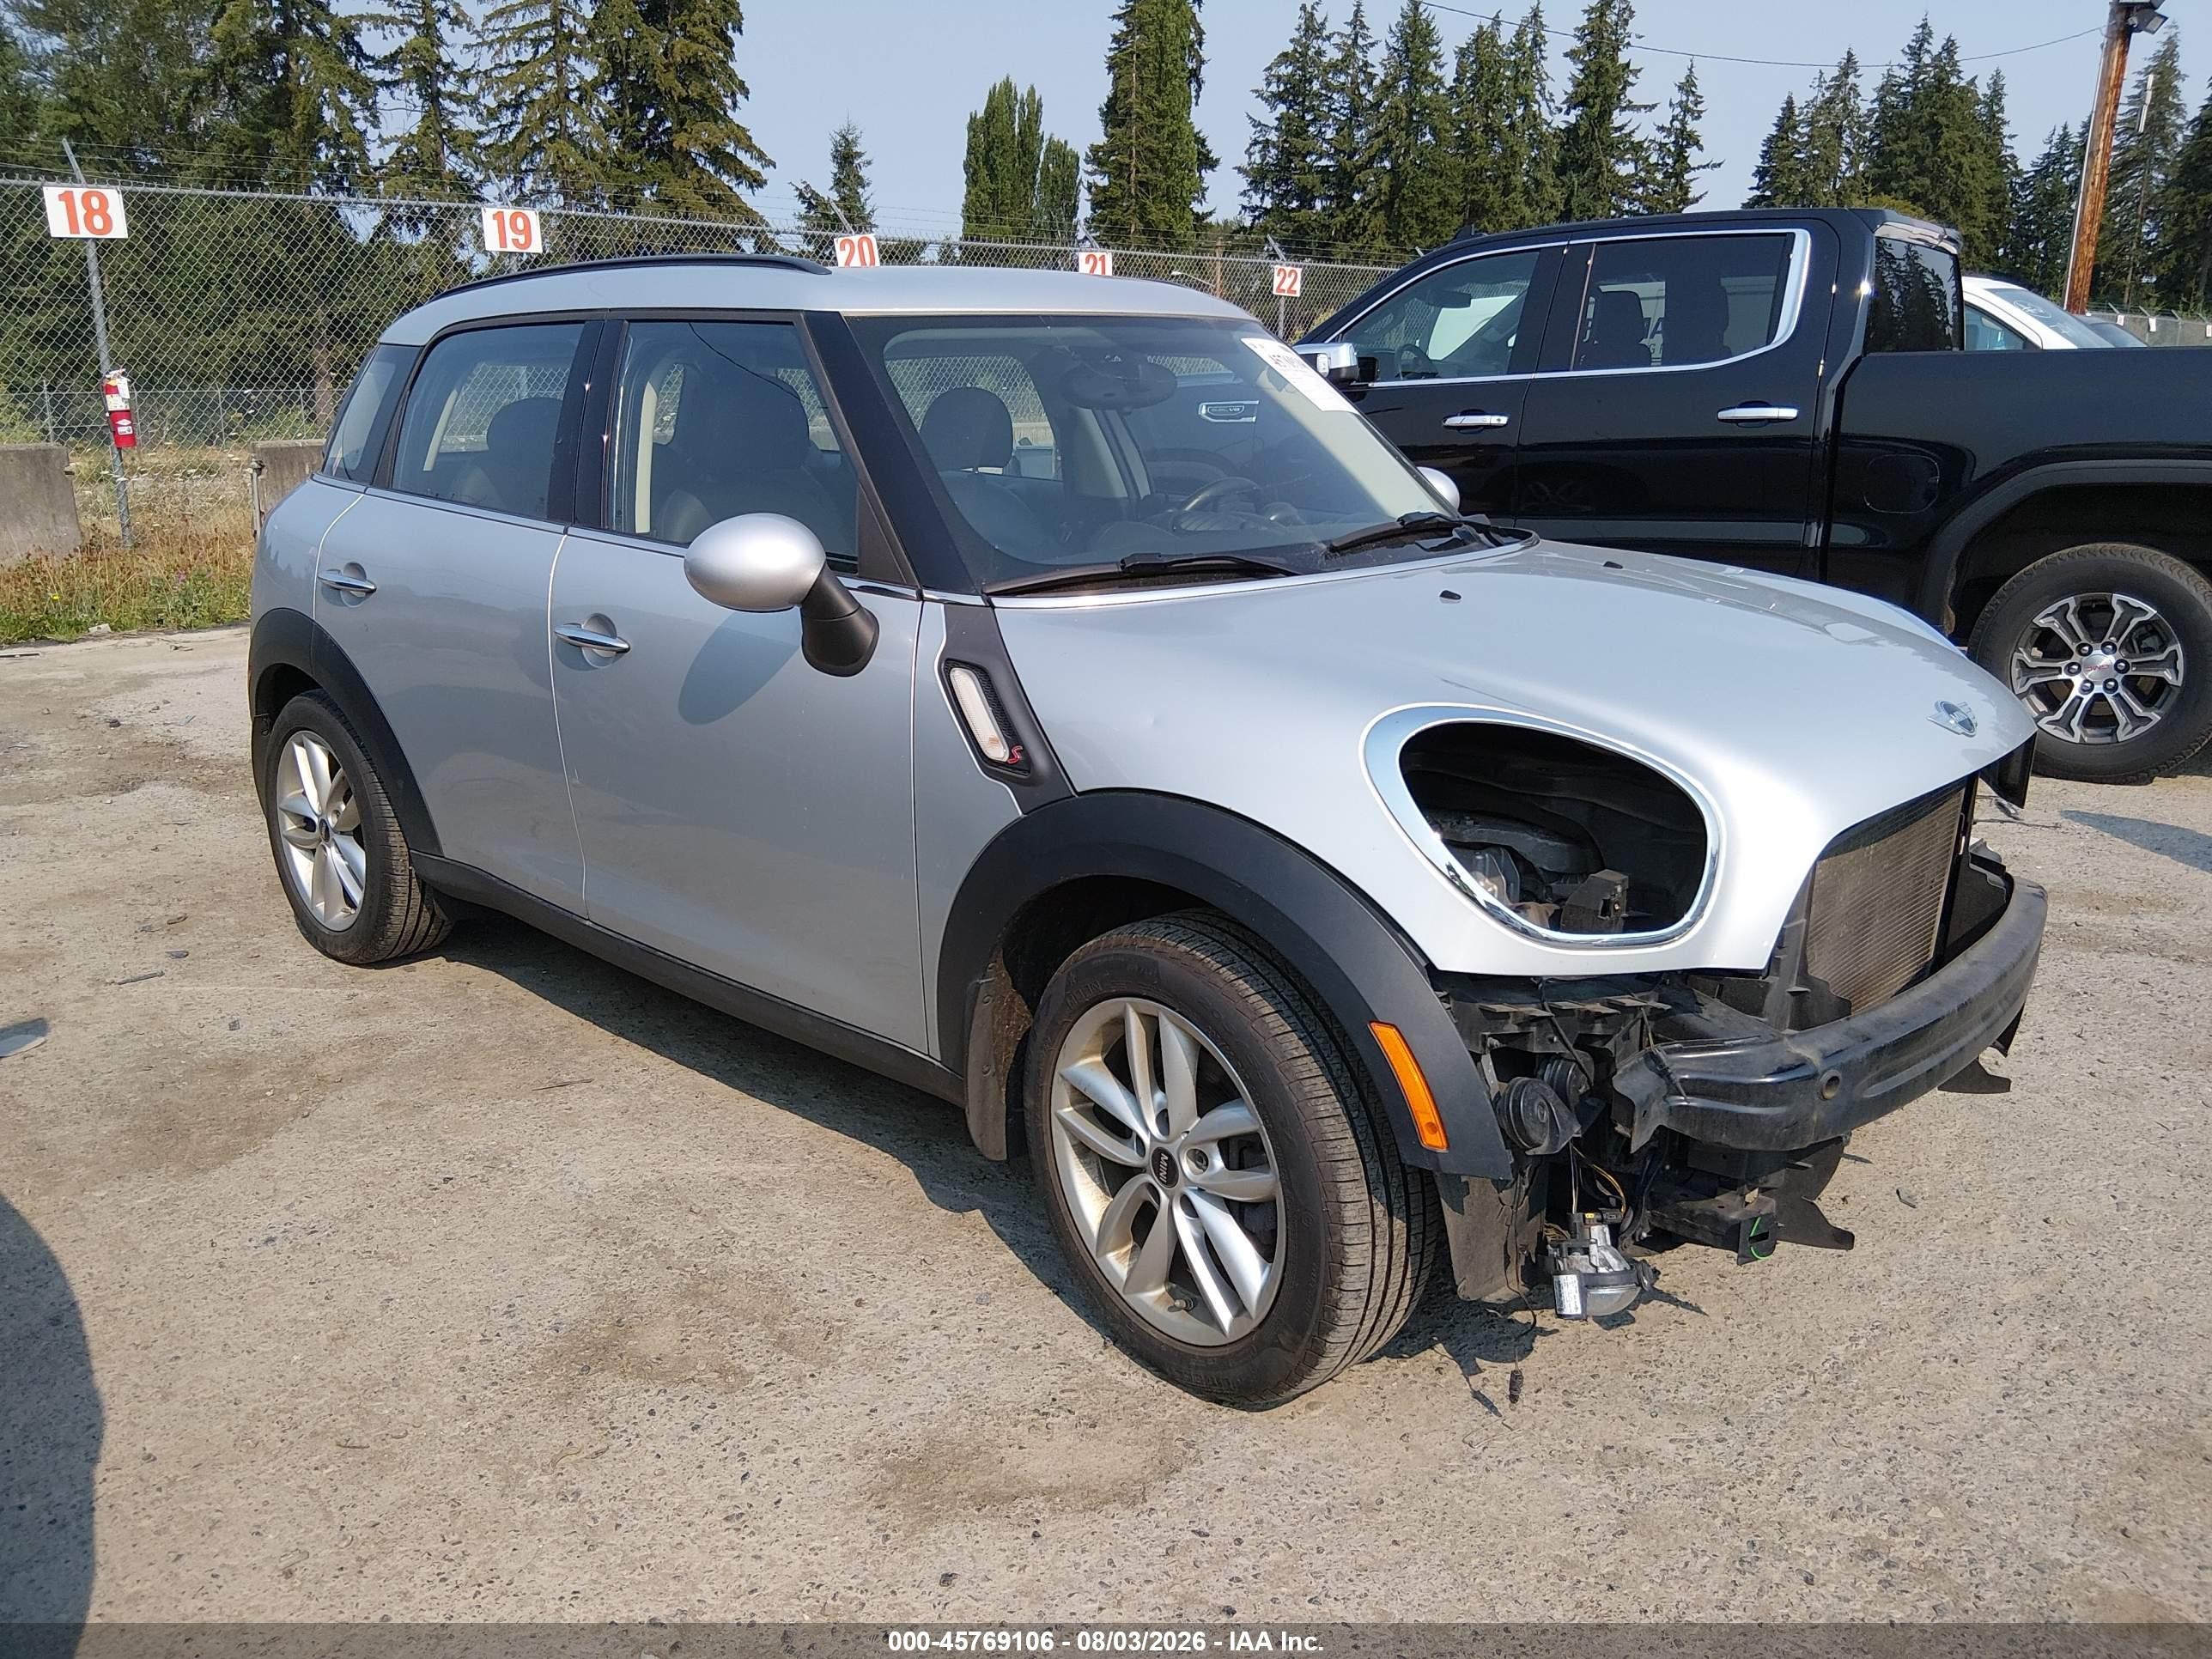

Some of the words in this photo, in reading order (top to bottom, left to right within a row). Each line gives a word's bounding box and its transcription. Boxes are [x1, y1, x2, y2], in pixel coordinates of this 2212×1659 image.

[58, 190, 112, 235] 18
[494, 211, 532, 250] 19
[840, 236, 876, 266] 20
[1085, 253, 1107, 276] 21
[1277, 268, 1297, 295] 22
[2086, 664, 2110, 672] GMC
[1007, 744, 1024, 764] S
[1158, 1152, 1169, 1183] MINI
